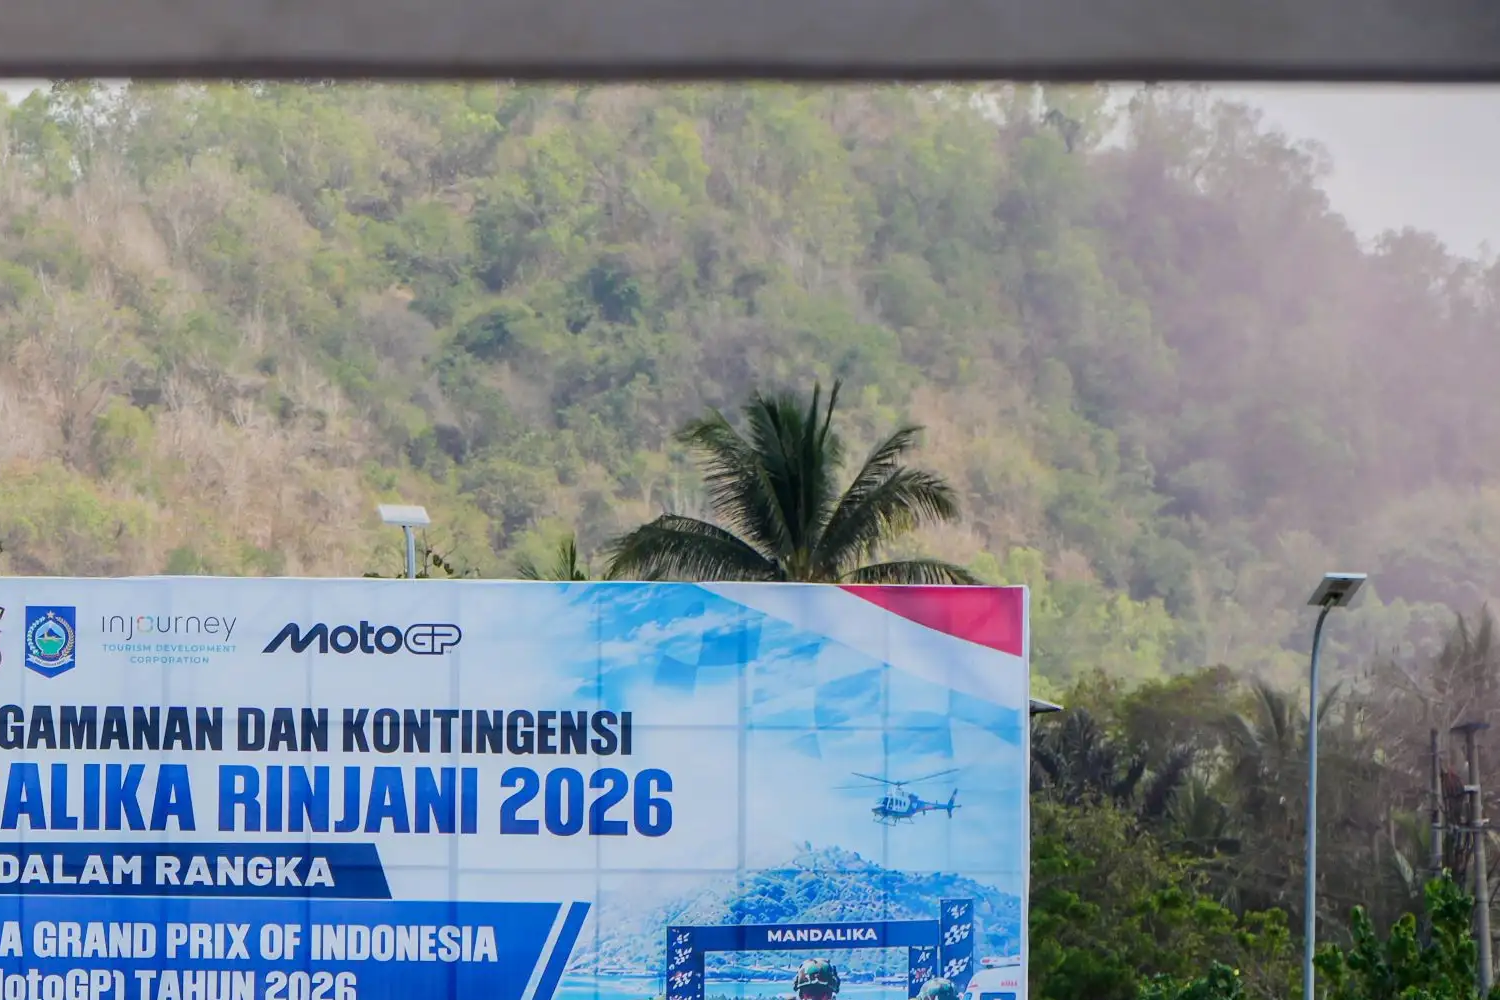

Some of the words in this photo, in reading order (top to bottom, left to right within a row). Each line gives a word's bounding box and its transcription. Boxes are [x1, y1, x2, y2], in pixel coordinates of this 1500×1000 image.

[102, 644, 150, 652] TOURISM
[156, 644, 236, 653] DEVELOPMENT
[261, 620, 462, 655] MotoGP
[130, 656, 209, 664] CORPORATION
[237, 707, 328, 752] DAN
[342, 708, 633, 755] KONTINGENSI
[218, 765, 478, 834] RINJANI
[500, 767, 674, 837] 2026
[155, 855, 336, 887] RANGKA
[33, 921, 157, 959] GRAND
[166, 923, 251, 960] PRIX
[259, 923, 301, 961] OF
[311, 924, 499, 963] INDONESIA
[767, 928, 878, 943] MANDALIKA
